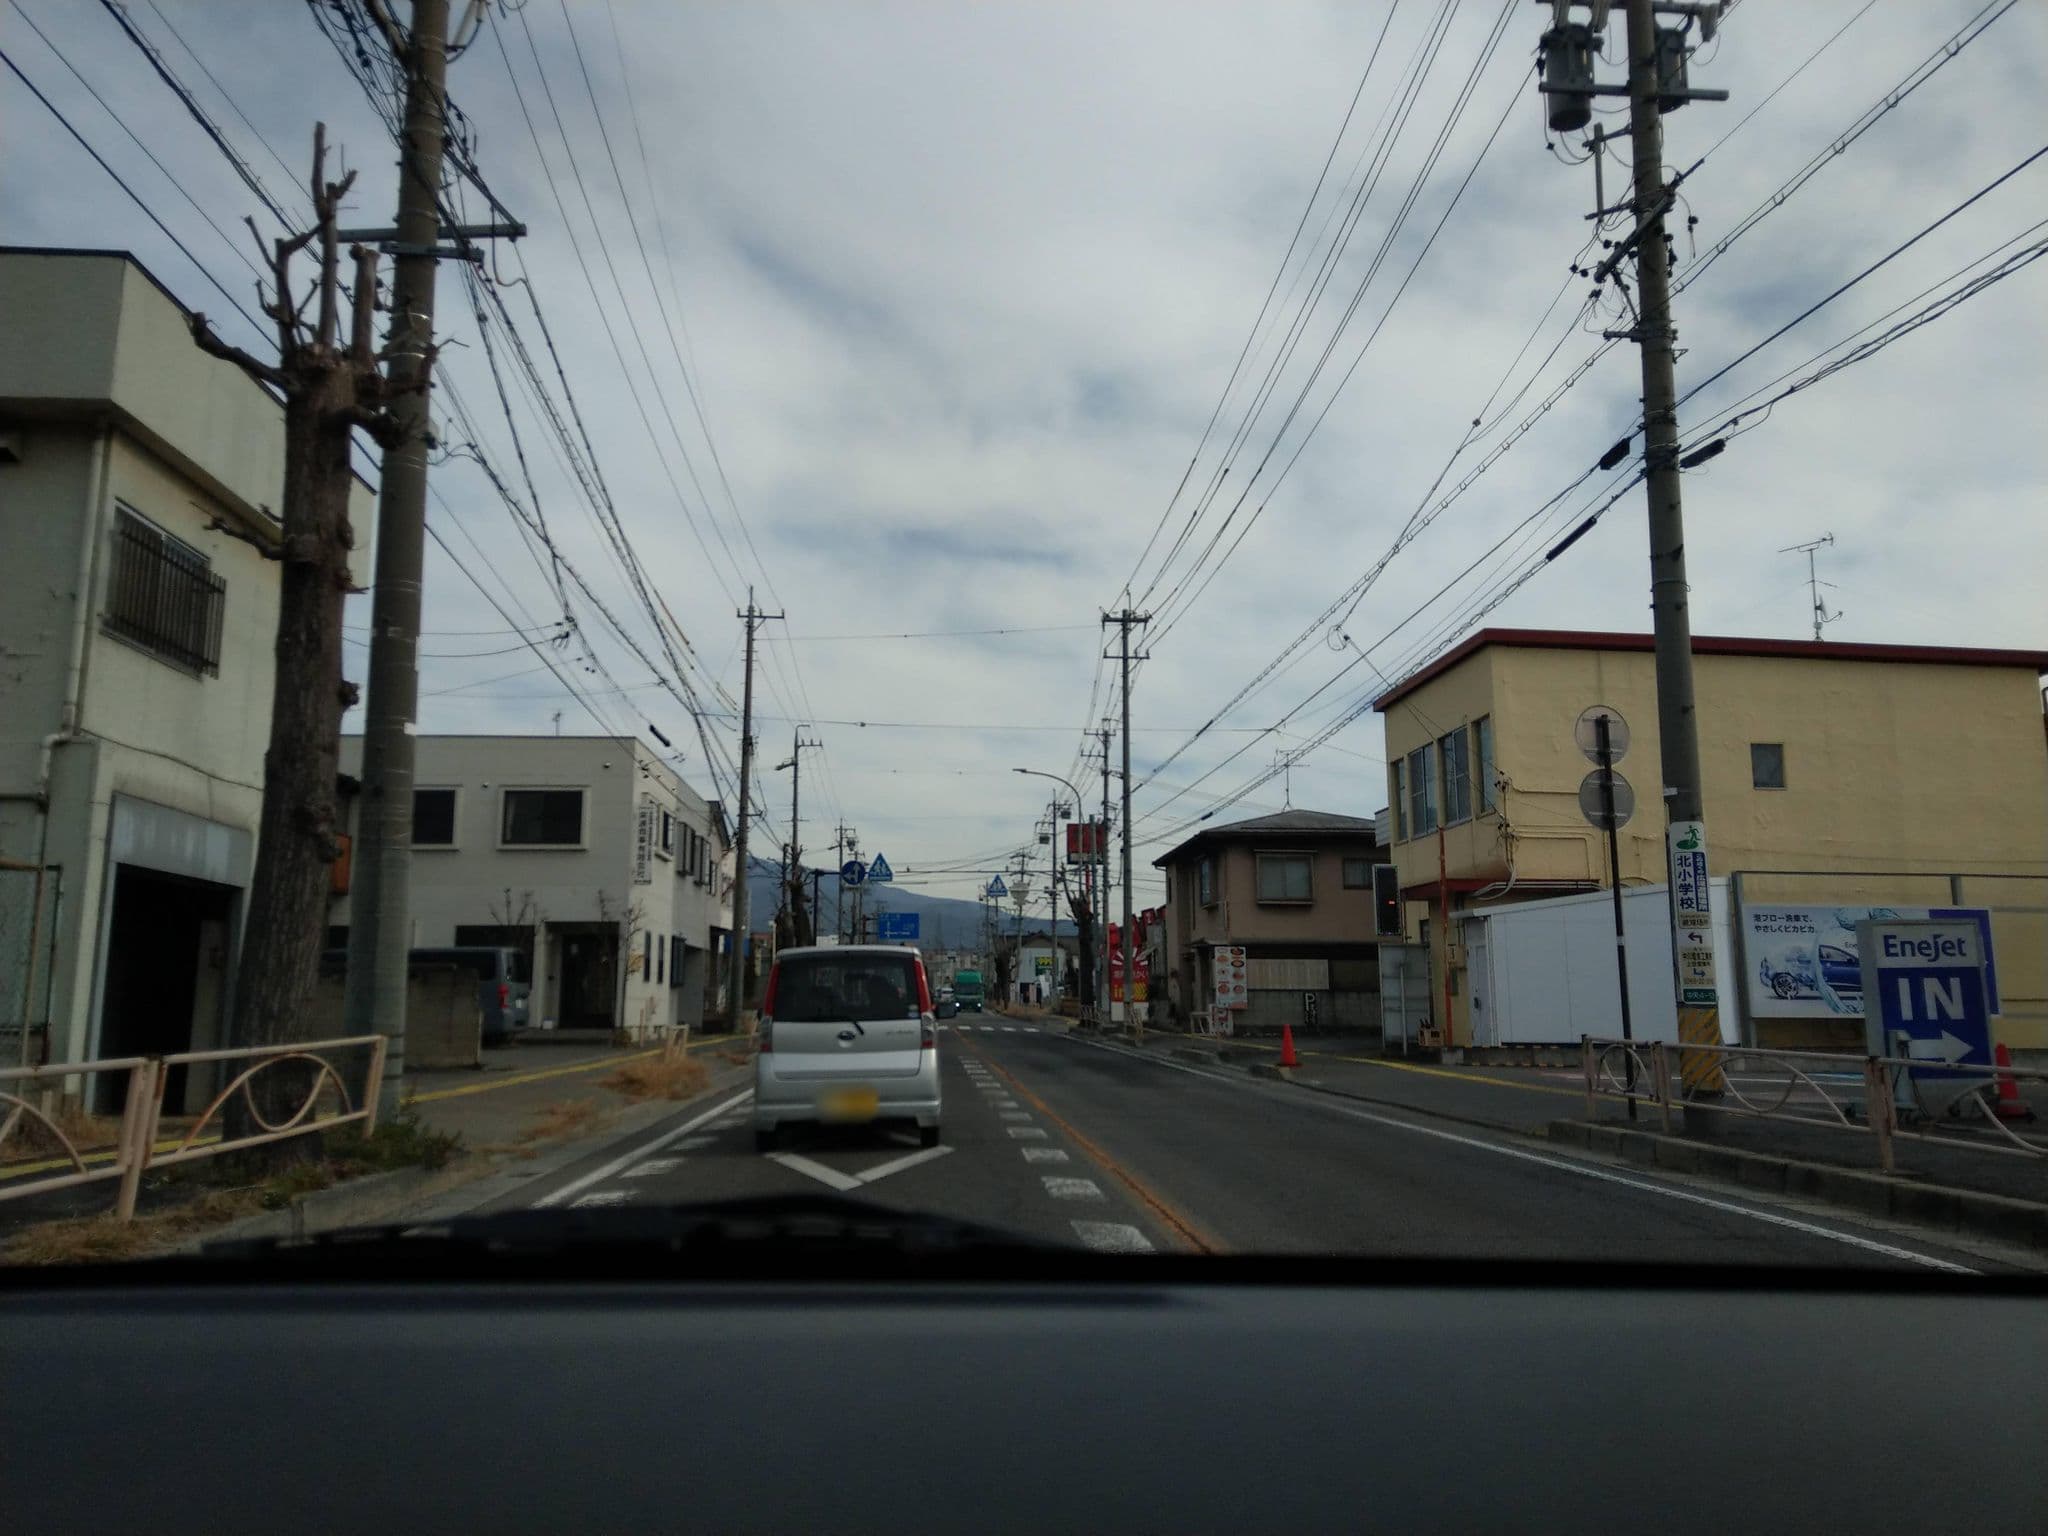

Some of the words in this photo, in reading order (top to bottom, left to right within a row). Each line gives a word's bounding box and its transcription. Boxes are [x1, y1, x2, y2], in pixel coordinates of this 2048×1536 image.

[1677, 855, 1695, 910] 北小学校
[1883, 934, 1967, 962] EneJet
[1898, 977, 1965, 1021] IN
